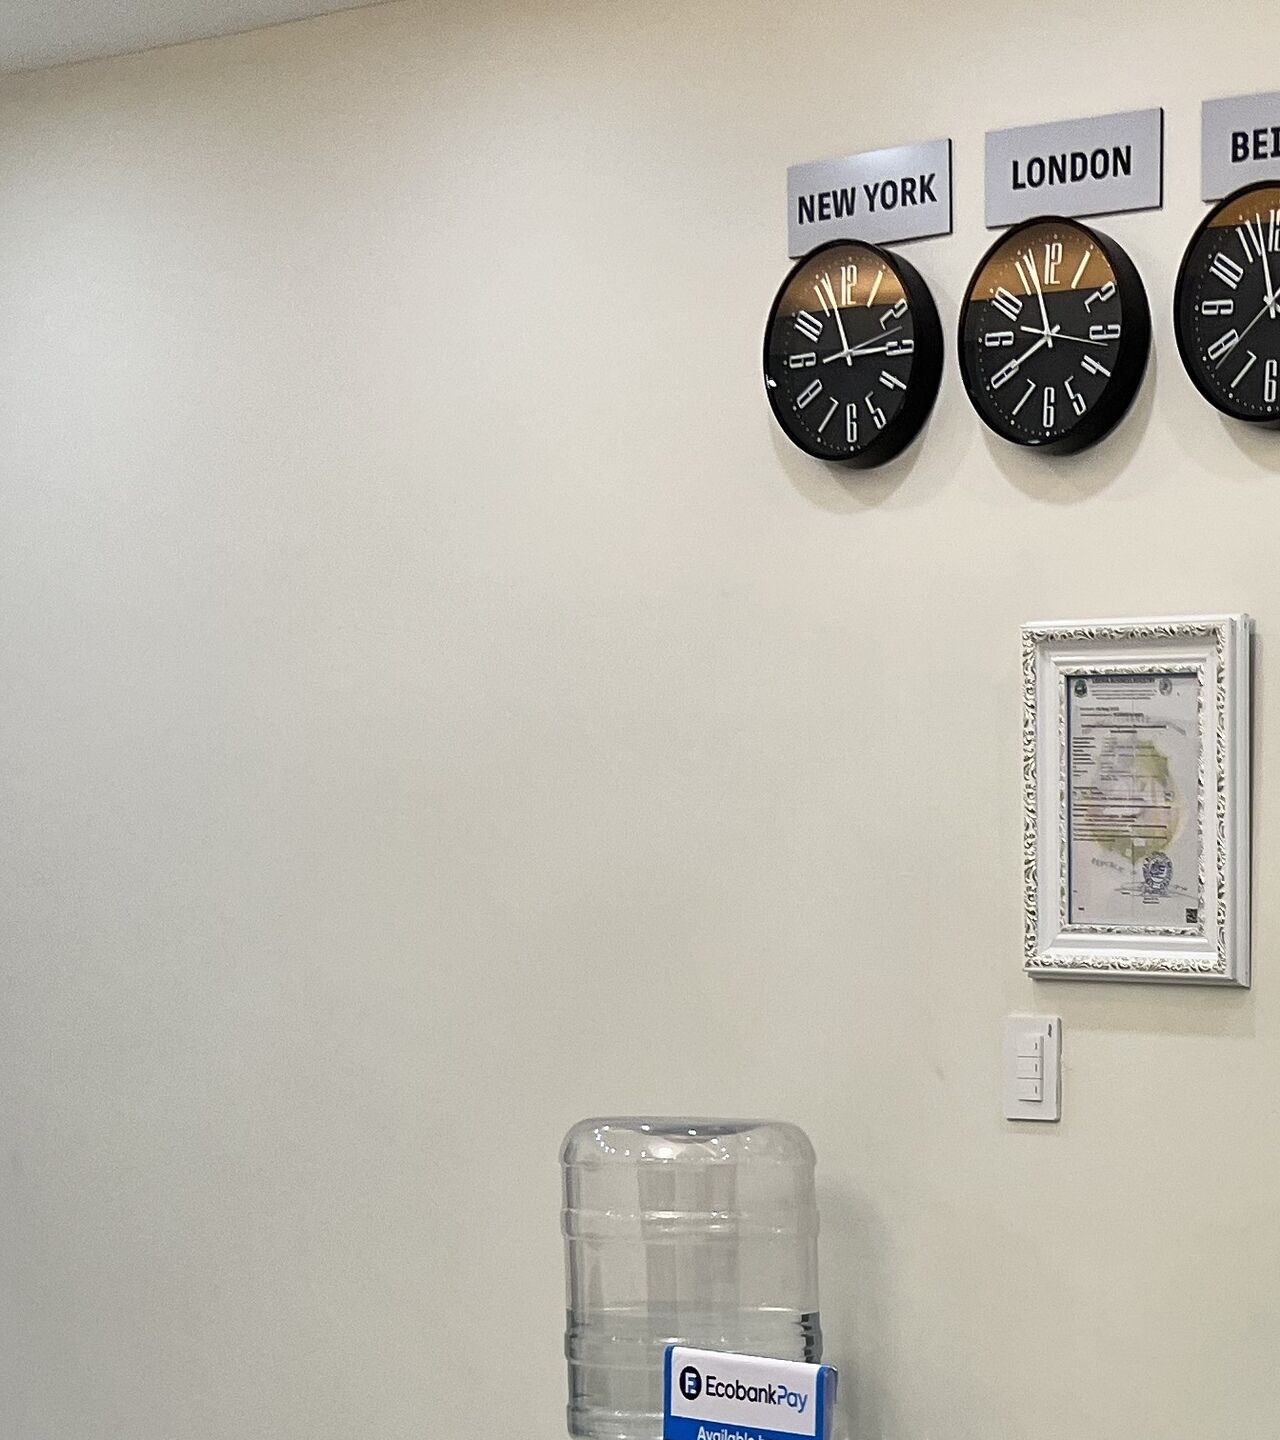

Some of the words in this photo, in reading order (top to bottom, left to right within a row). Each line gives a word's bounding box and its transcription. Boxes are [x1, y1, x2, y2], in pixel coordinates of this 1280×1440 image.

[1012, 145, 1132, 190] LONDON
[797, 186, 857, 225] NEW
[862, 172, 938, 213] YORK
[1044, 243, 1063, 285] 12
[1071, 251, 1090, 289] 1
[841, 264, 858, 306] 12
[866, 270, 884, 308] 1
[1084, 281, 1116, 314] 2
[879, 298, 909, 331] 2
[1201, 299, 1234, 315] 9
[885, 339, 915, 356] 3
[984, 331, 1014, 347] 9
[1089, 324, 1121, 340] 3
[1207, 328, 1239, 360] 8
[789, 352, 817, 369] 9
[990, 358, 1019, 390] 8
[1080, 354, 1111, 377] 4
[1230, 350, 1257, 388] 7
[796, 379, 822, 409] 8
[879, 370, 908, 390] 4
[1012, 378, 1036, 416] 7
[1064, 375, 1087, 416] 5
[1263, 359, 1278, 403] 6
[818, 396, 839, 433] 7
[846, 403, 857, 443] 6
[865, 391, 887, 430] 5
[1043, 386, 1055, 428] 6
[705, 1375, 809, 1413] EcobankPay
